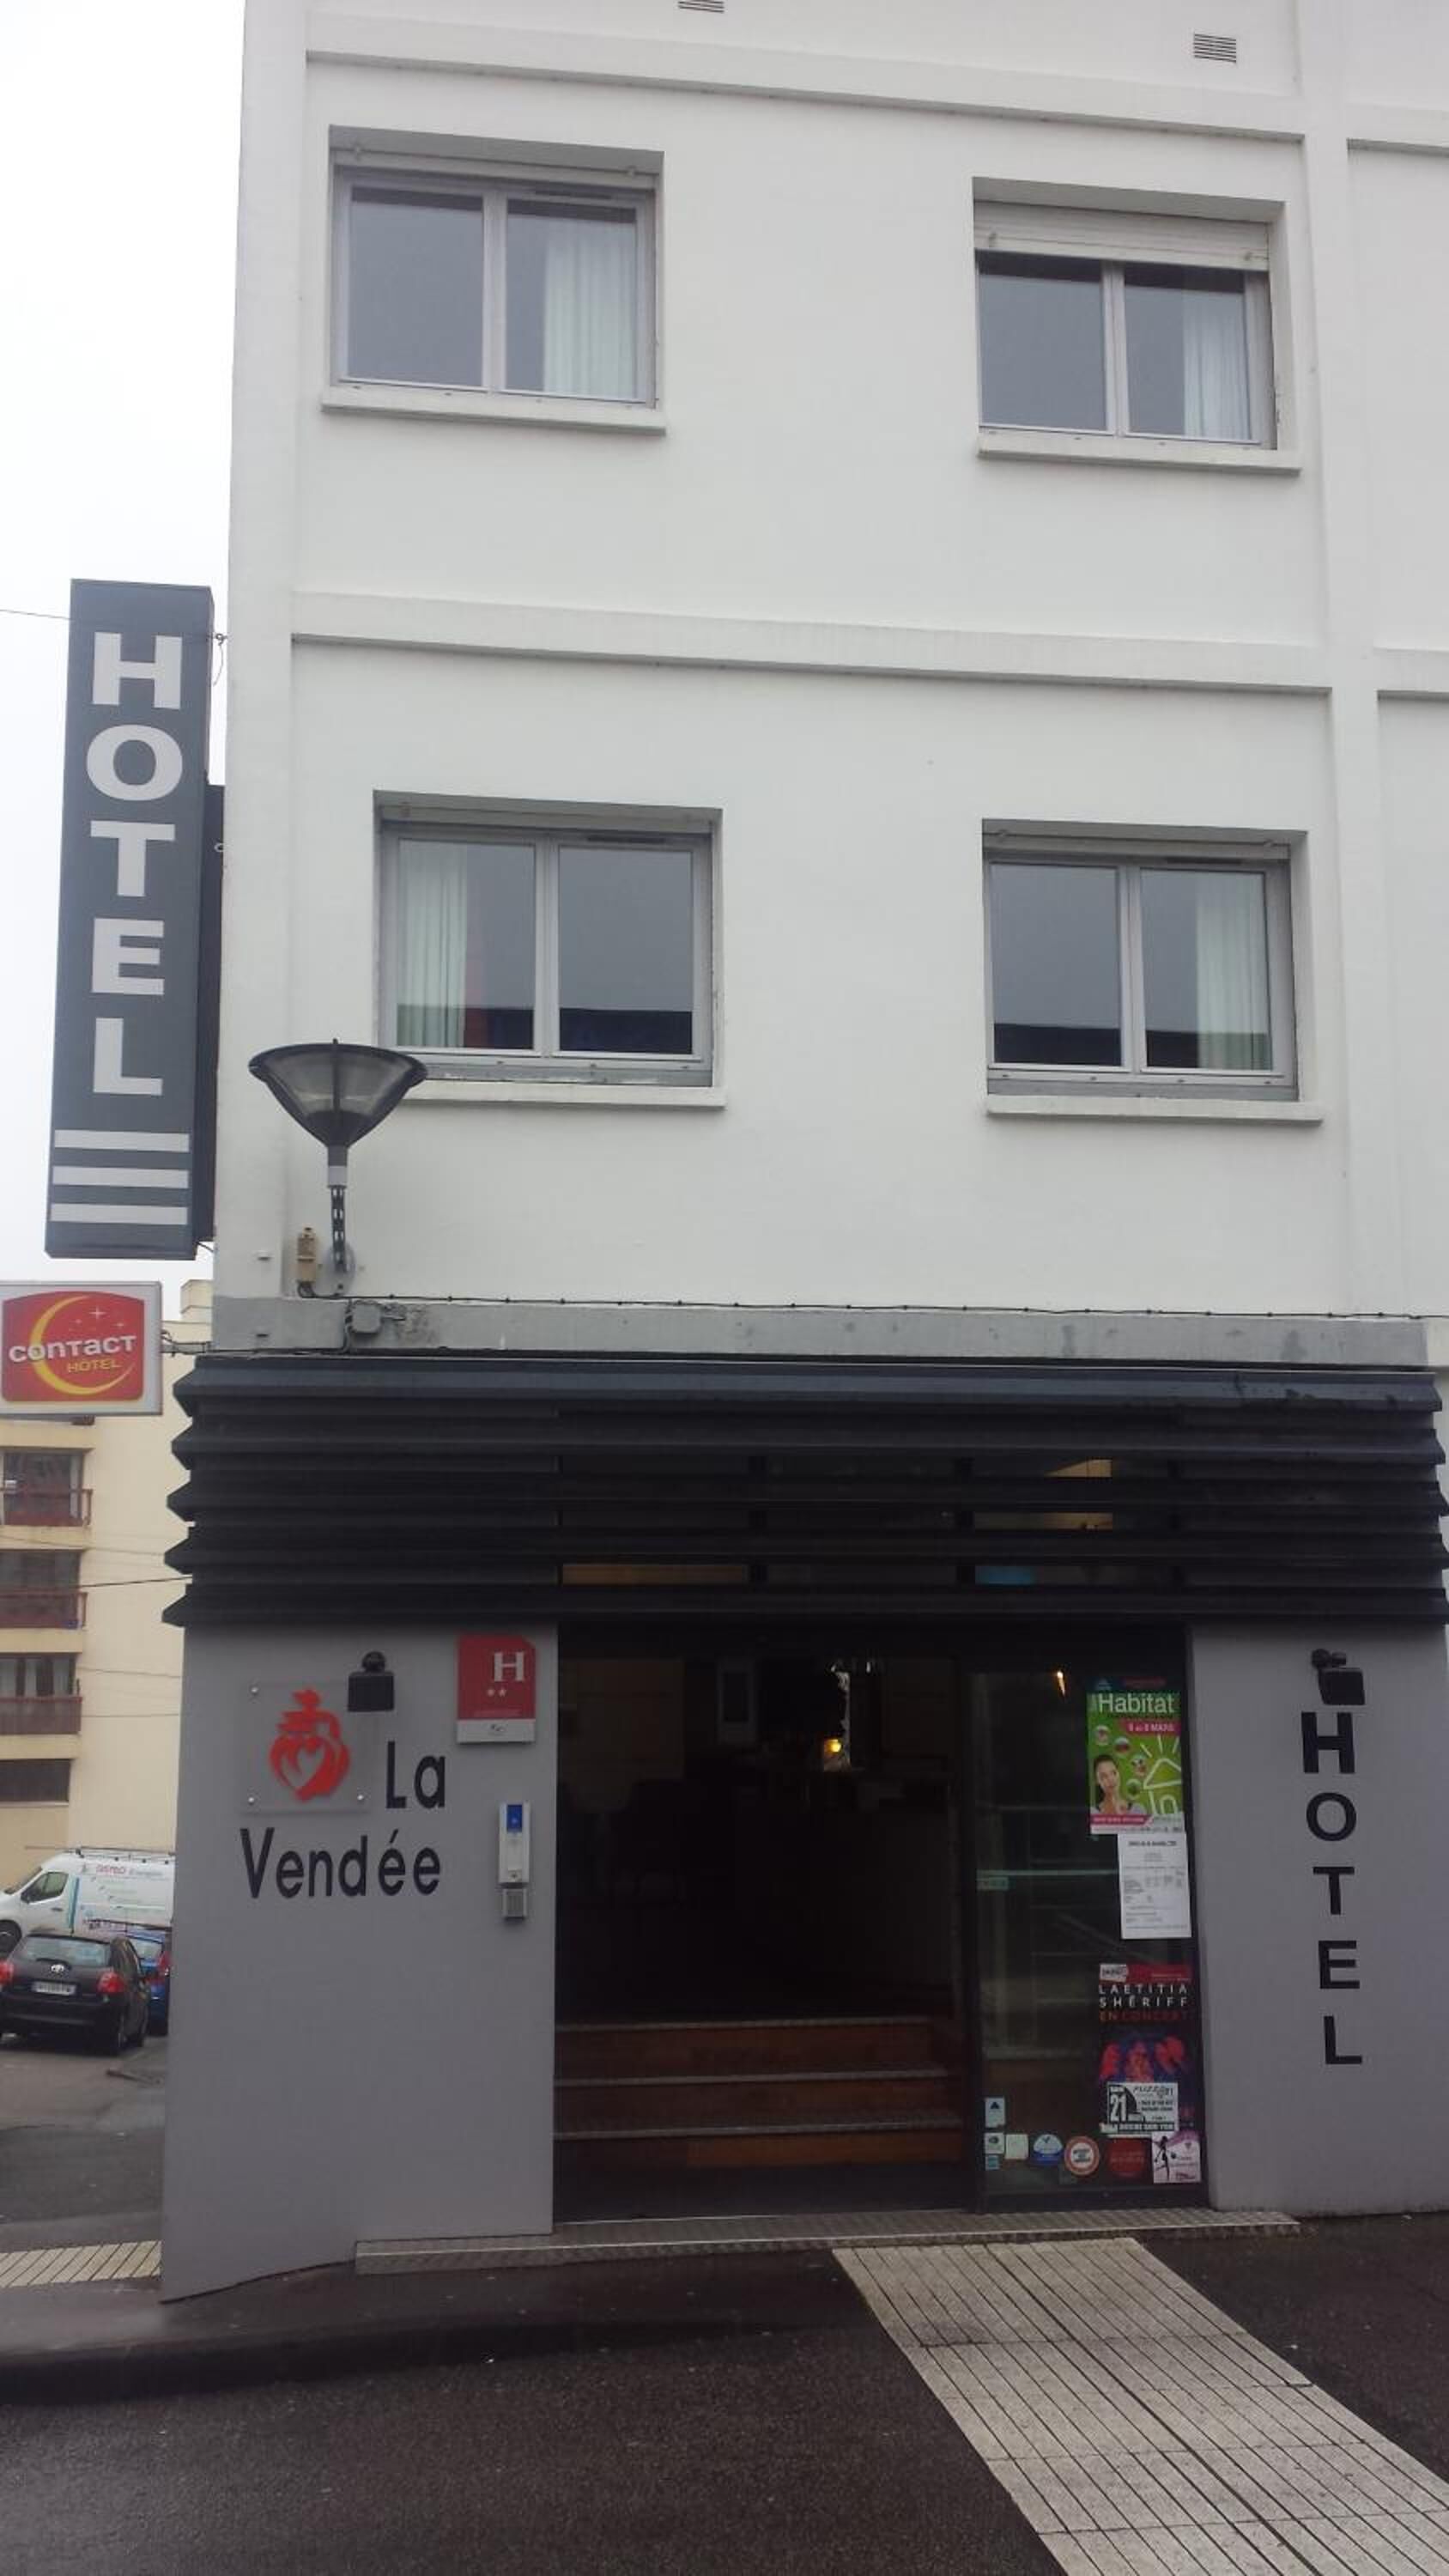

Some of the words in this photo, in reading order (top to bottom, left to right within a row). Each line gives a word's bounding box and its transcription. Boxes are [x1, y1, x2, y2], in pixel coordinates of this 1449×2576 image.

[86, 632, 183, 1097] HOTEL
[68, 1359, 122, 1373] HOTEL
[494, 1651, 525, 1682] H
[1098, 1692, 1175, 1713] Habitat
[385, 1741, 446, 1809] La
[239, 1827, 441, 1899] Vendée
[1300, 1711, 1363, 2064] HOTEL
[1099, 1984, 1187, 1995] LAETITIA
[1110, 2093, 1127, 2122] 21
